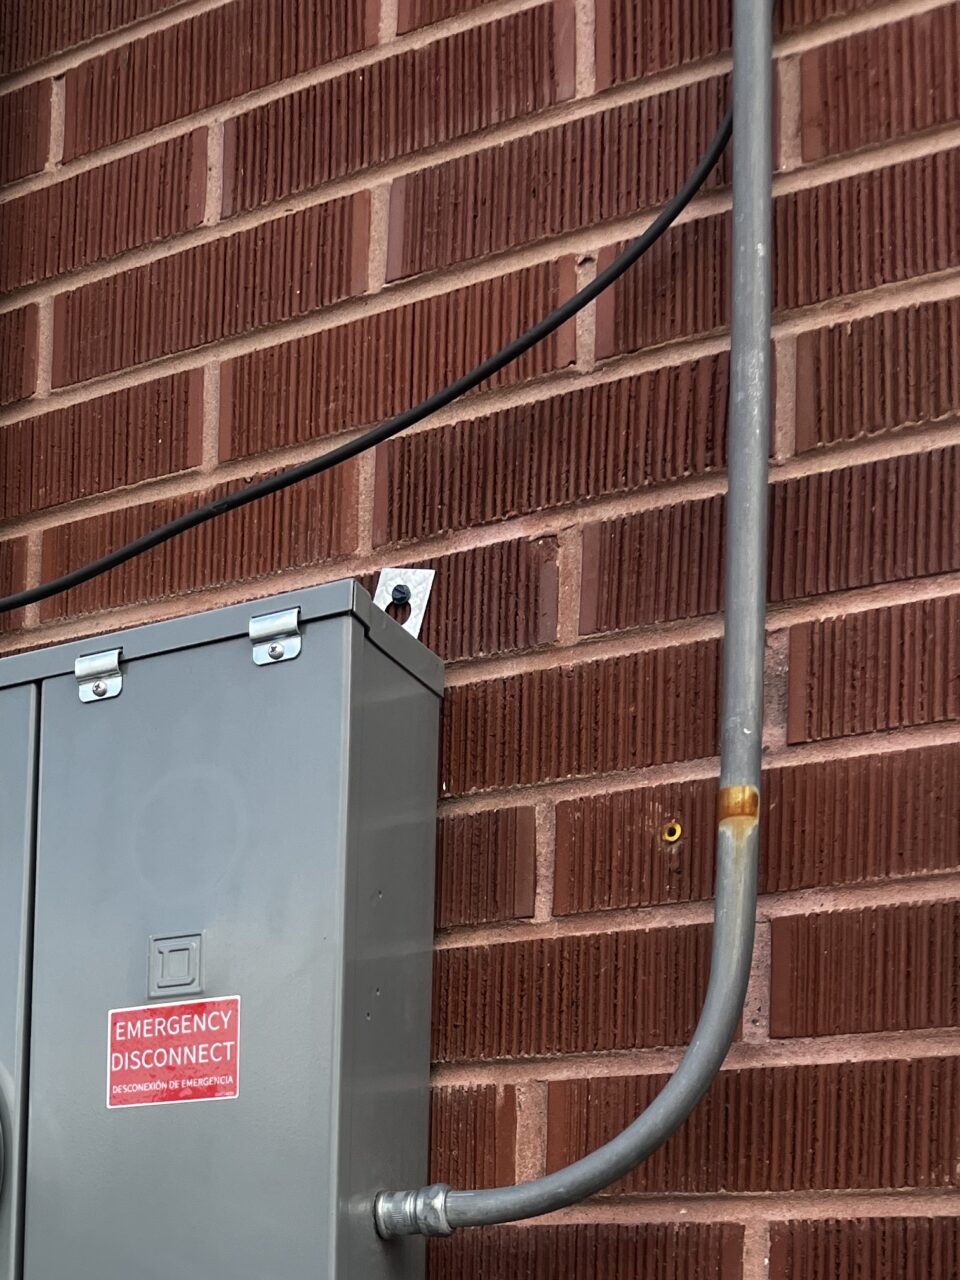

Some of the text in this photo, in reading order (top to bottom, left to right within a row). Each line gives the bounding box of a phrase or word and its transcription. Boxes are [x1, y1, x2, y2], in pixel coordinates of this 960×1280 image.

[116, 1010, 232, 1040] EMERGENCY
[111, 1041, 235, 1071] DISCONNECT
[112, 1075, 233, 1094] DESCONEXIÓN DE EMERGENCIA
